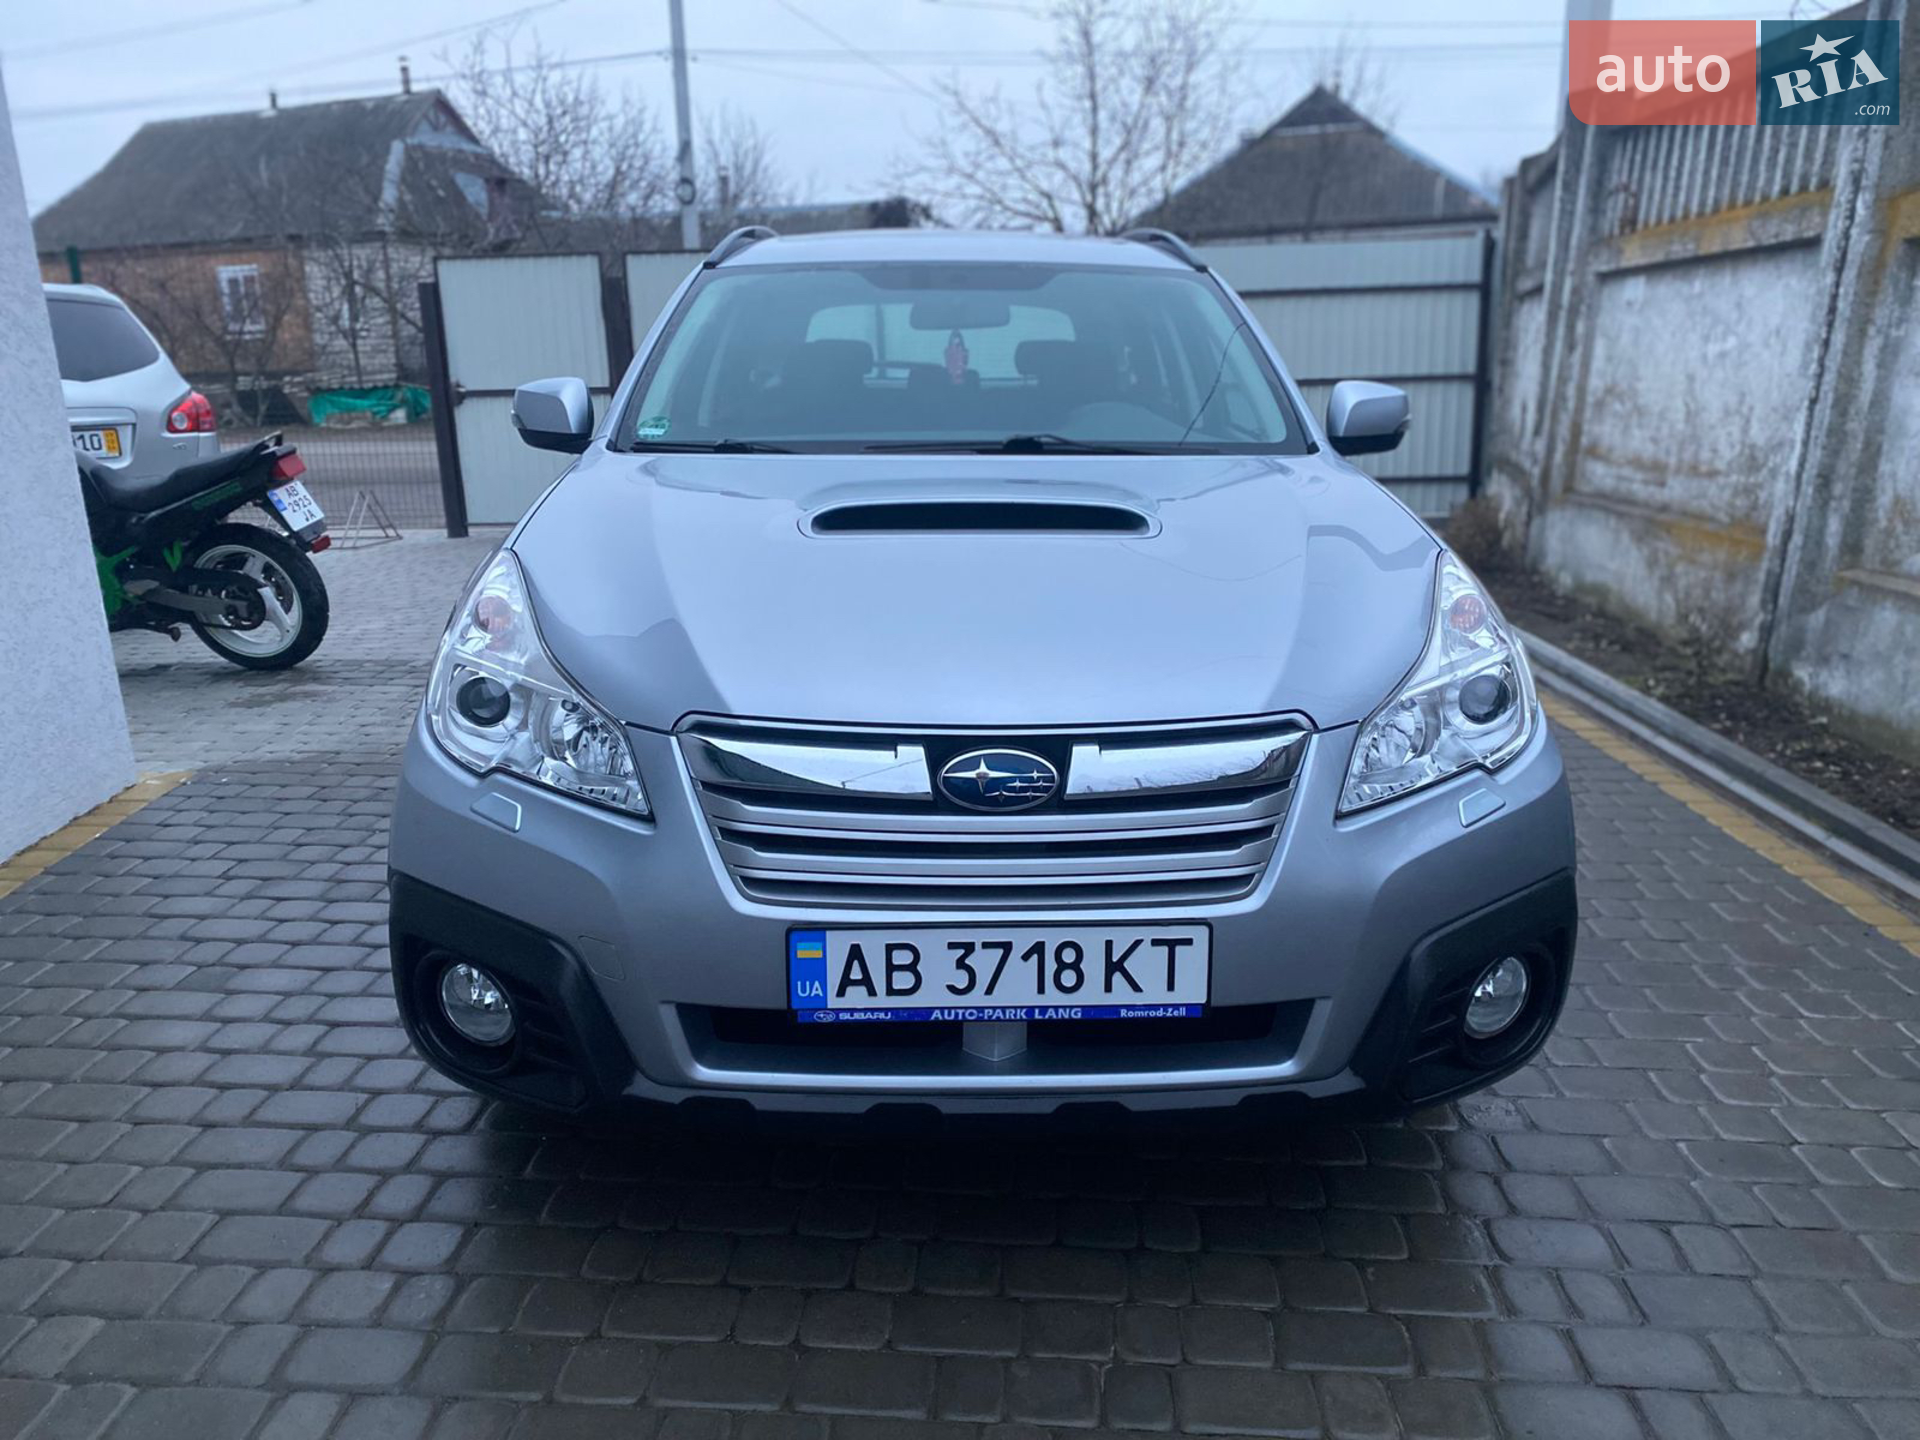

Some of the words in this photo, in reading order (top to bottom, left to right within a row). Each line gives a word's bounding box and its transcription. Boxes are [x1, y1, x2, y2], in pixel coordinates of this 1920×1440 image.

[72, 433, 103, 452] 10
[285, 485, 300, 499] AB
[288, 495, 312, 513] 2925
[835, 941, 922, 998] AB
[946, 940, 1085, 996] 3718
[1104, 938, 1194, 993] KT
[797, 981, 824, 998] UA
[838, 1011, 892, 1020] SUBARU
[930, 1007, 1028, 1021] AUTO-PARK
[1034, 1007, 1083, 1019] LANG
[1120, 1008, 1187, 1018] Romrod-Zell
